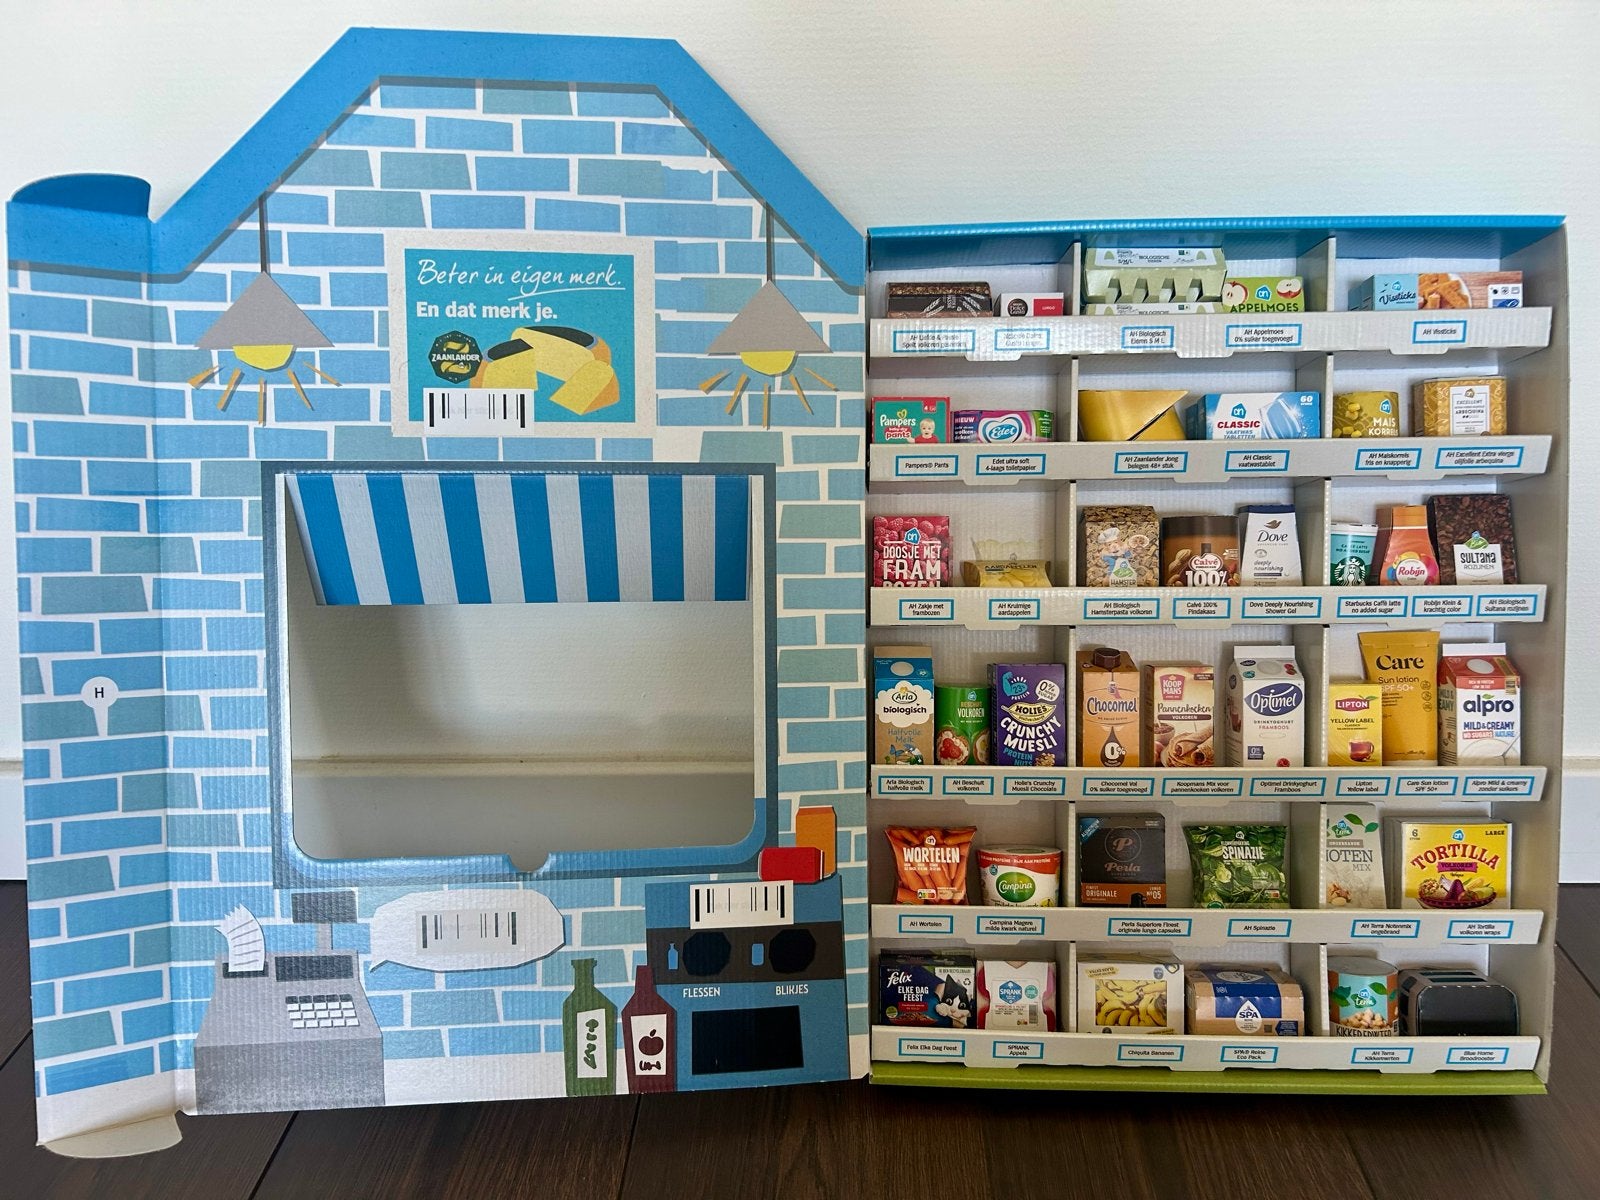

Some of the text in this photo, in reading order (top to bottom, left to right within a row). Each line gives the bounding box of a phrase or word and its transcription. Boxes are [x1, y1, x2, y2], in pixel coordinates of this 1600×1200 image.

[417, 260, 621, 296] Beter in eigen merk.
[416, 302, 557, 321] En dat merk je.
[1230, 303, 1299, 313] APPELMOES
[432, 354, 480, 362] ZAANLANDER
[880, 414, 916, 426] Pampers
[1217, 421, 1260, 429] CLASSIC
[1373, 417, 1395, 426] MAIS
[991, 425, 1016, 437] Edet
[1369, 428, 1398, 436] KORRELS
[1258, 530, 1288, 542] Dove
[883, 546, 941, 559] DOOSJE MET
[1194, 558, 1218, 566] Calvé
[883, 560, 941, 580] FRAM
[1398, 566, 1425, 575] Robijn
[1186, 571, 1227, 587] 100%
[1376, 655, 1424, 671] Care
[1163, 680, 1182, 689] KOOP
[94, 688, 104, 698] H
[895, 693, 913, 701] Arla
[1163, 687, 1182, 695] MANS
[1250, 686, 1296, 712] Optimel
[883, 706, 927, 715] biologisch
[1087, 698, 1137, 714] Chocomel
[1157, 703, 1211, 714] Pannenkoeken
[1463, 695, 1514, 716] alpro
[958, 708, 984, 717] VOLKOREN
[1001, 716, 1061, 737] CRUNCHY
[1004, 736, 1057, 752] MUESLI
[1104, 742, 1126, 757] 0%
[1003, 748, 1032, 760] PROTEIN
[903, 847, 960, 863] WORTELEN
[1222, 847, 1264, 859] SPINAZIE
[1411, 844, 1500, 870] TORTILLA
[1105, 863, 1141, 872] Perla
[999, 880, 1032, 893] Campina
[887, 972, 912, 987] felix
[683, 987, 721, 998] FLESSEN
[775, 984, 809, 995] BLIKJES
[916, 986, 928, 994] DAG
